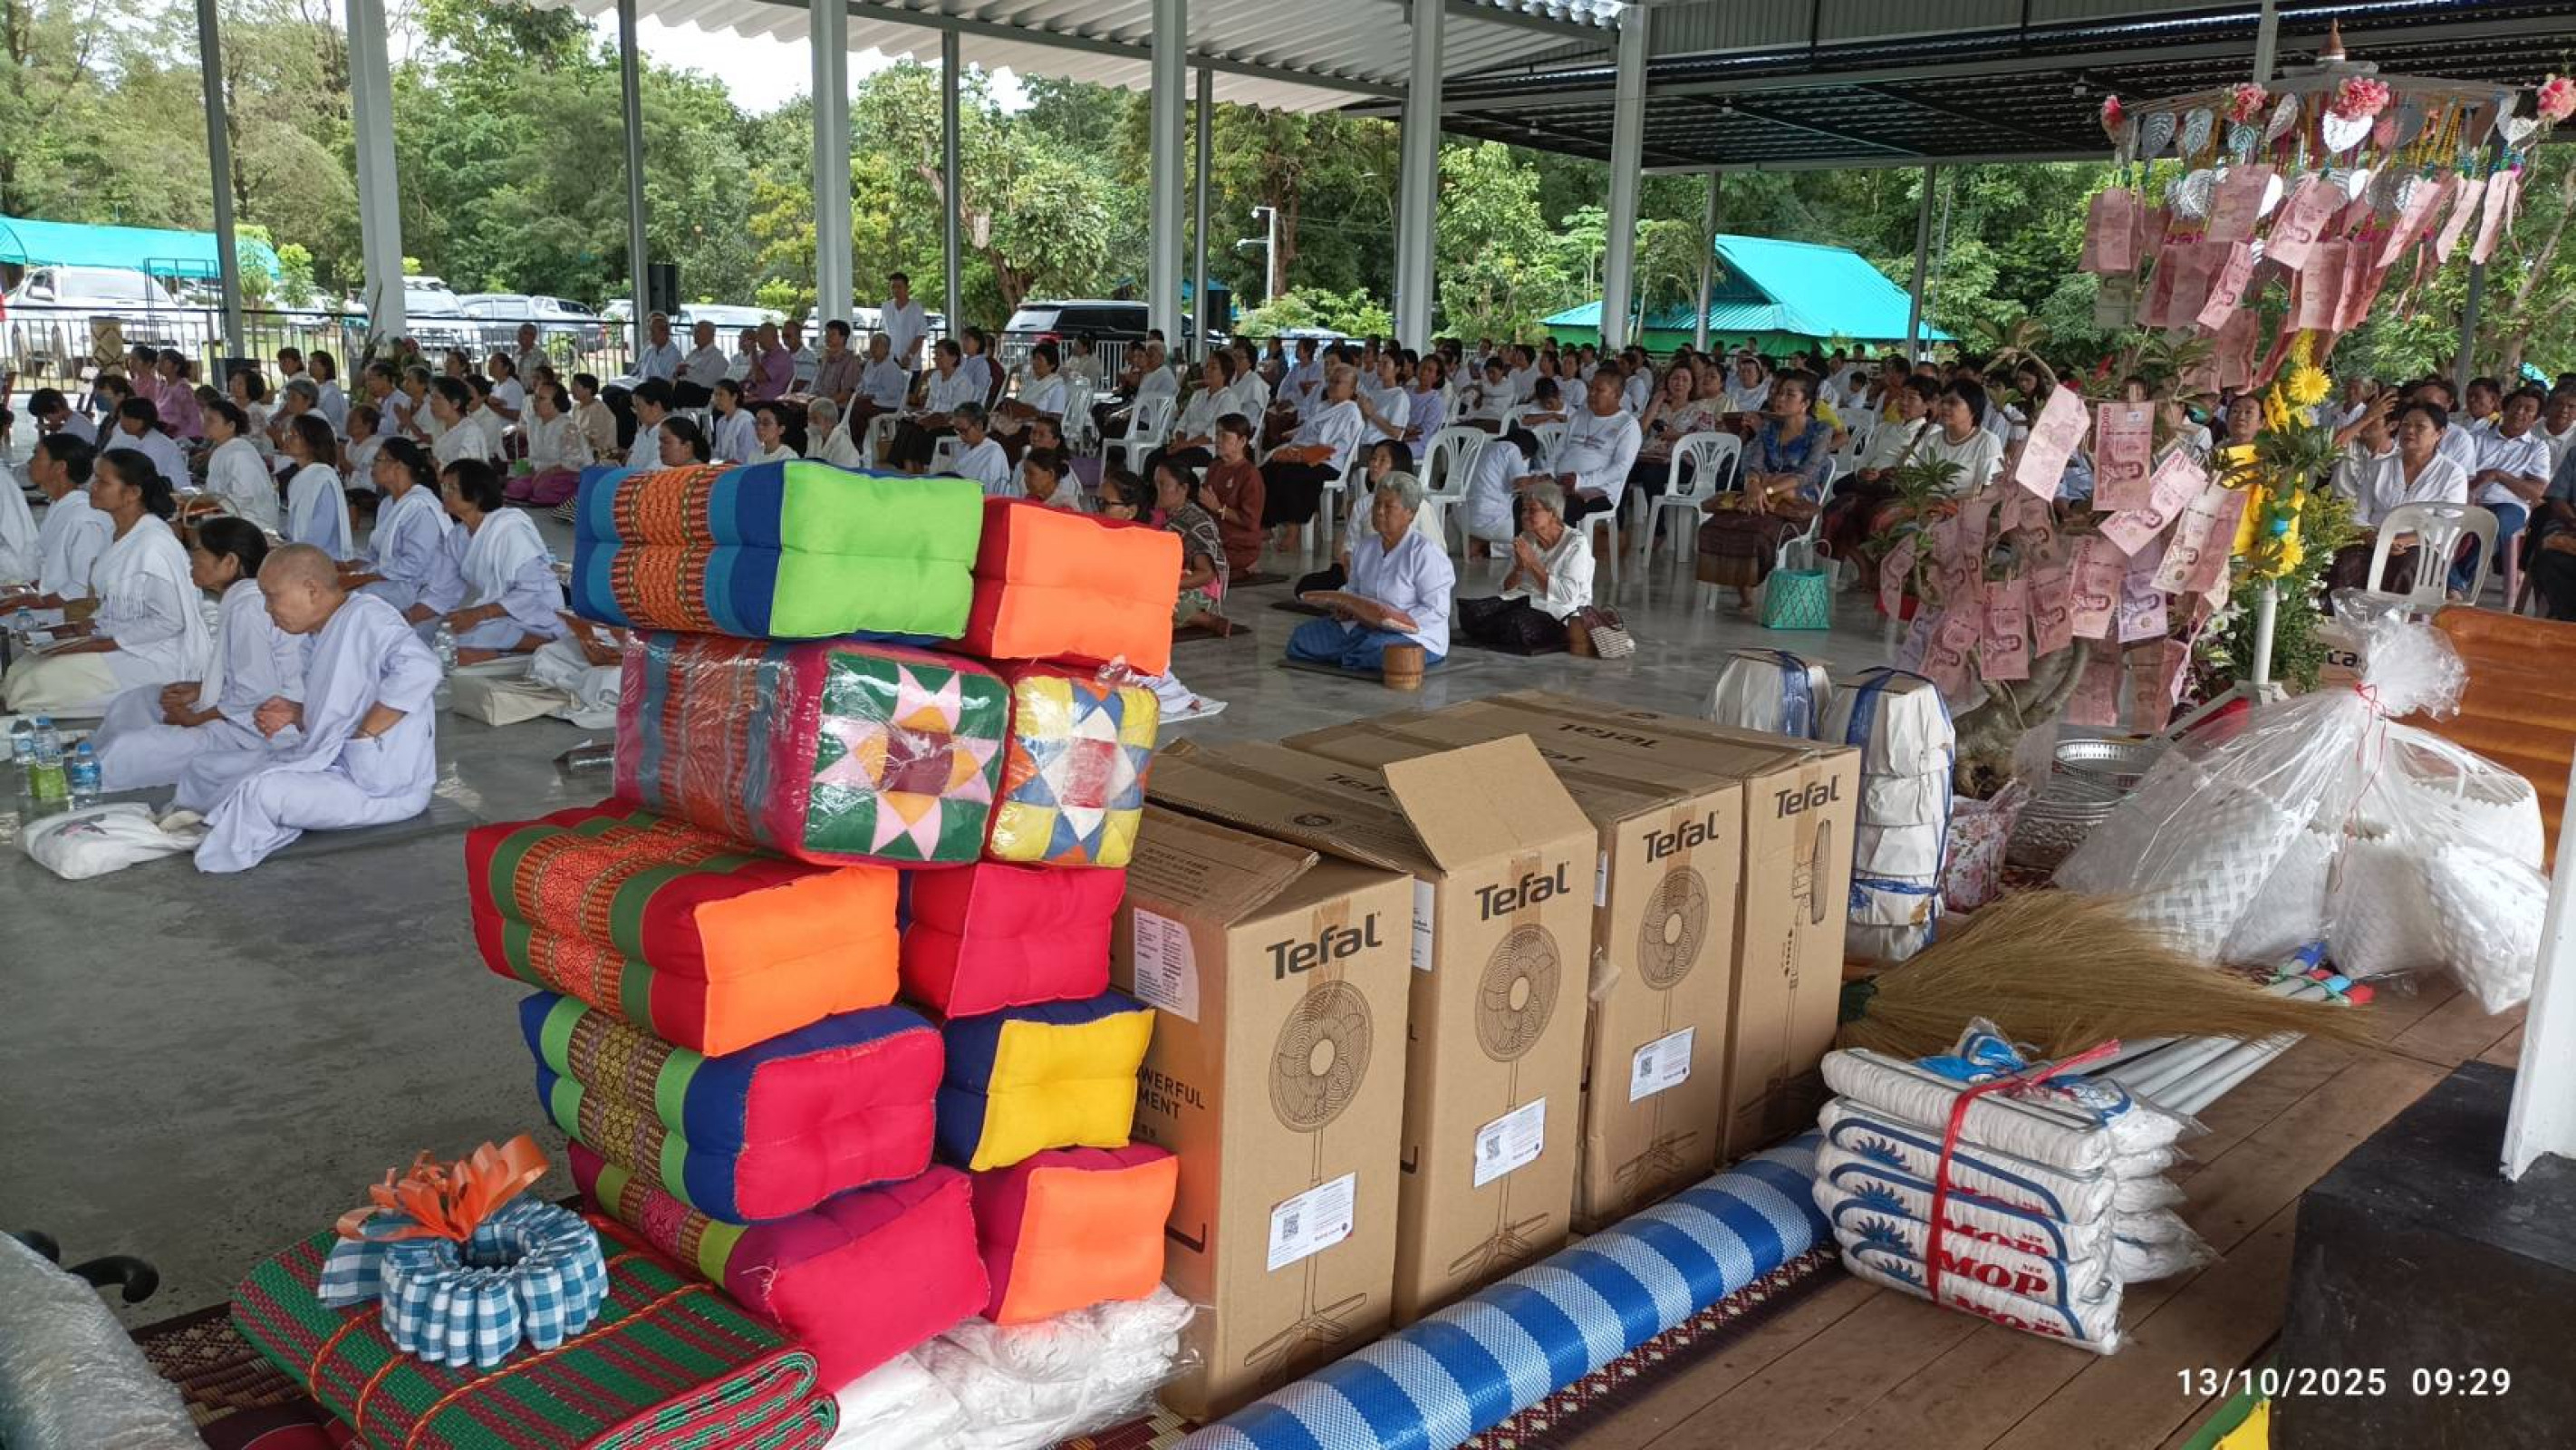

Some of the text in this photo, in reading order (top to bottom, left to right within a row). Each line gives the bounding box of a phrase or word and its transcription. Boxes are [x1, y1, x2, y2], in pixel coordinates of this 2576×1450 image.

[1558, 724, 1660, 749] Tefal
[1326, 773, 1391, 798] Tef
[1774, 775, 1839, 818] Tefal
[1642, 811, 1720, 864] Tefal
[1474, 863, 1571, 921] Tefal
[1266, 914, 1383, 981] Tefal
[1136, 1068, 1206, 1111] WERFUL
[1138, 1088, 1182, 1120] MENT
[1937, 1250, 2049, 1295] MOP
